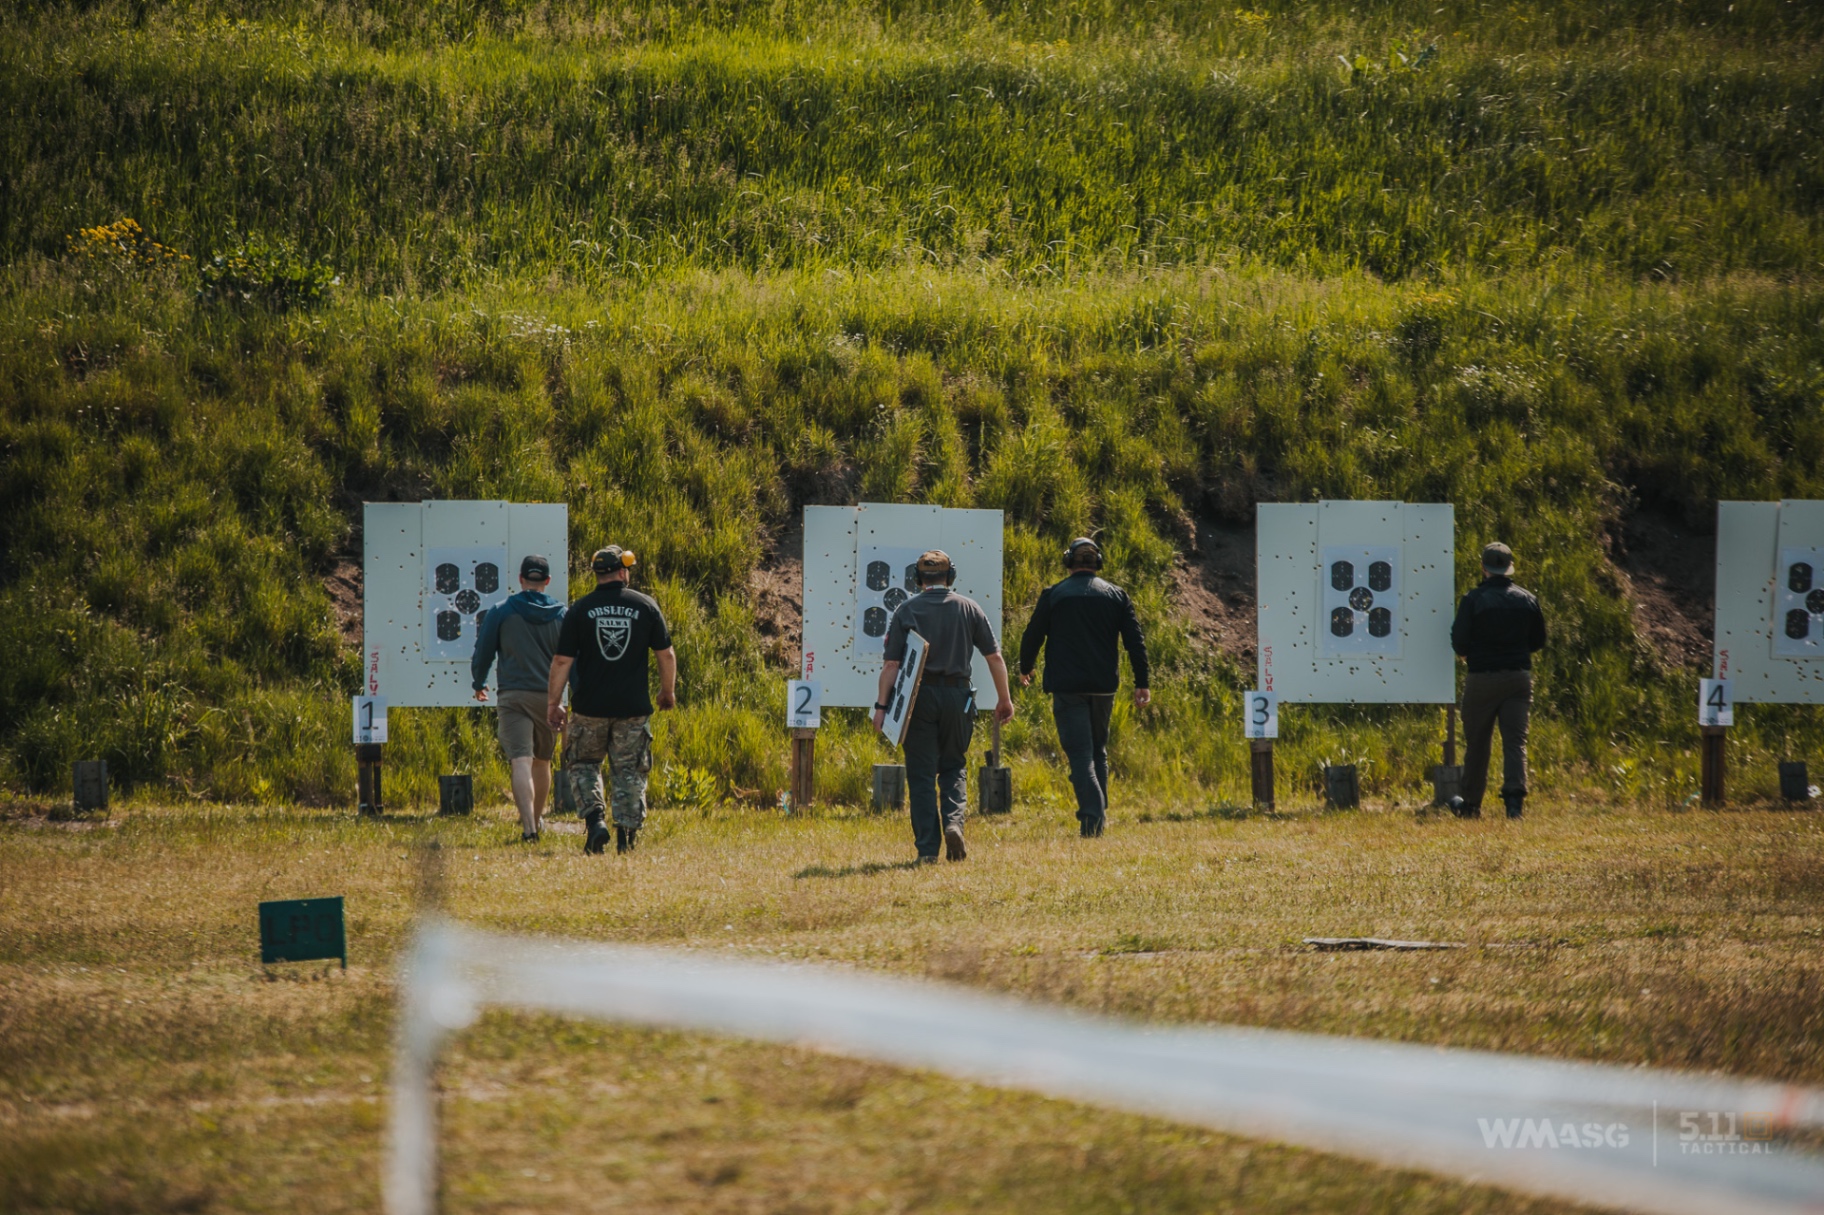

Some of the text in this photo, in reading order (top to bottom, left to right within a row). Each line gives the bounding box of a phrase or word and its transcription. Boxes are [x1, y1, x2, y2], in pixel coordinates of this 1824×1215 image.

[795, 686, 813, 715] 2
[1252, 696, 1270, 726] 3
[1706, 684, 1727, 713] 4
[361, 701, 379, 730] 1
